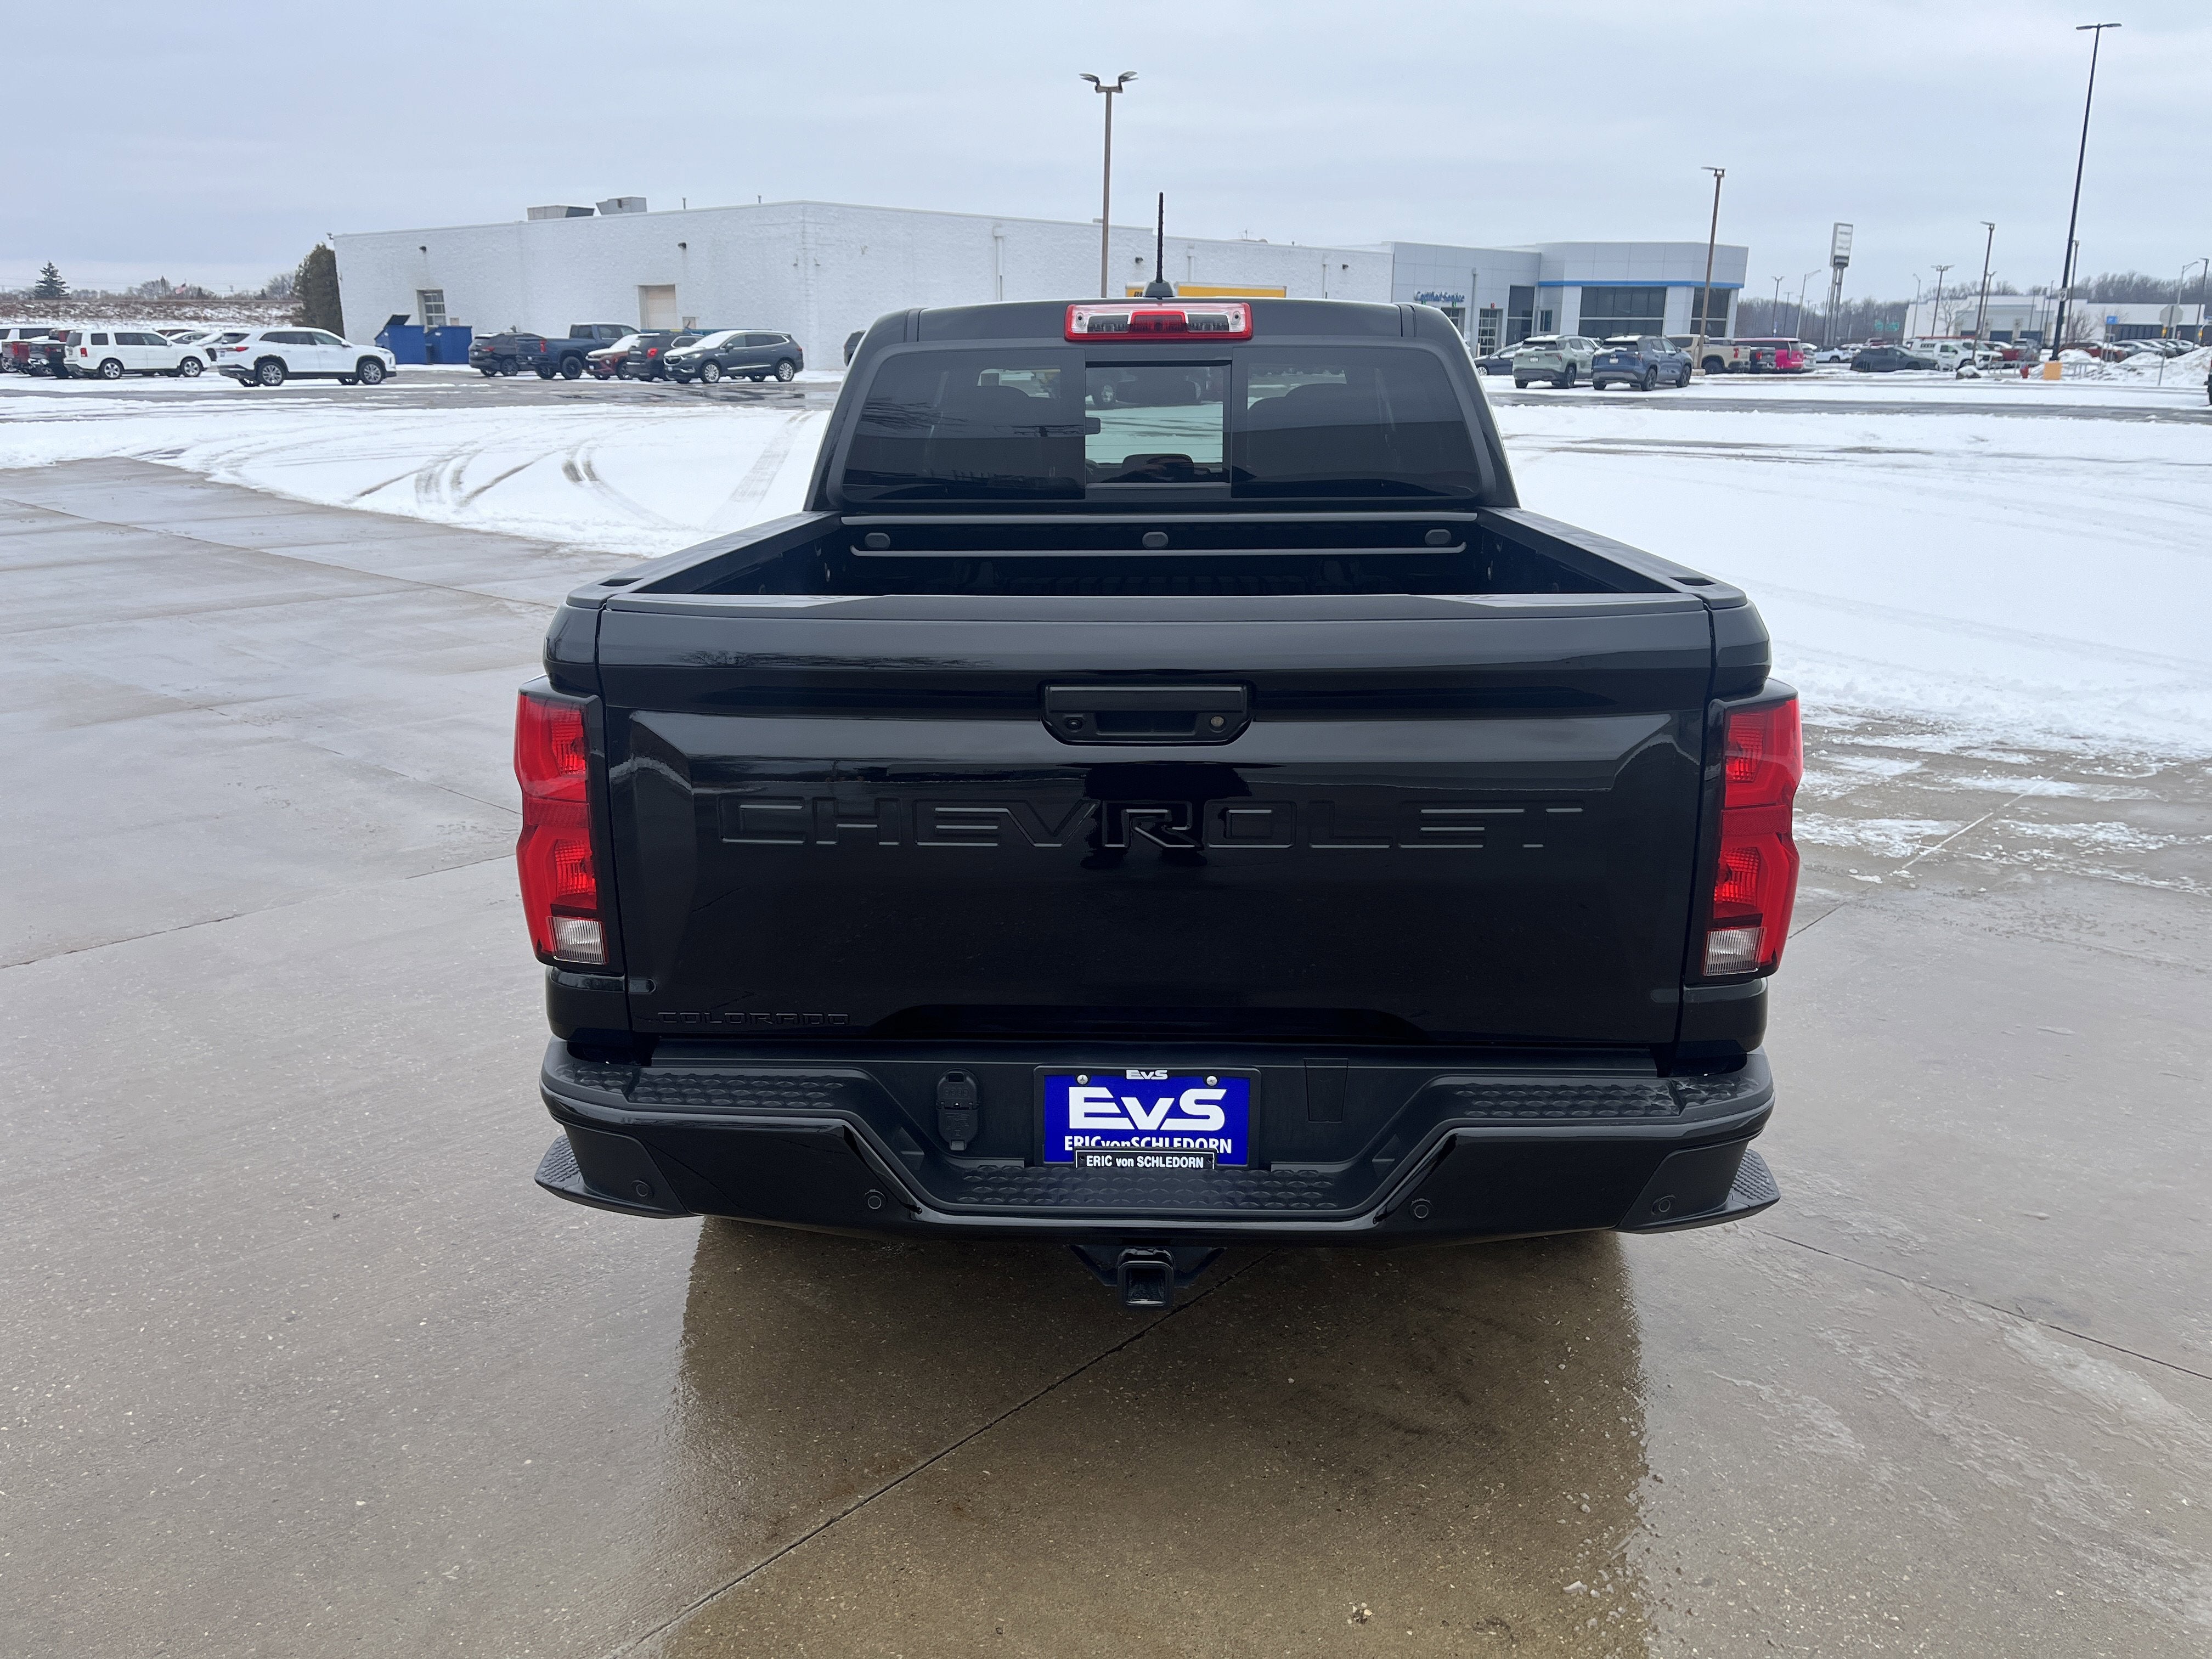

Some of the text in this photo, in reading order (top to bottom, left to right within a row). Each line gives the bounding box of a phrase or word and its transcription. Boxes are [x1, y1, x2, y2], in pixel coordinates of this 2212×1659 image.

[719, 797, 1584, 849] CHEVROLET
[658, 1011, 850, 1025] COLORADO
[1086, 1155, 1204, 1169] ERIC von SCHLEDORN
